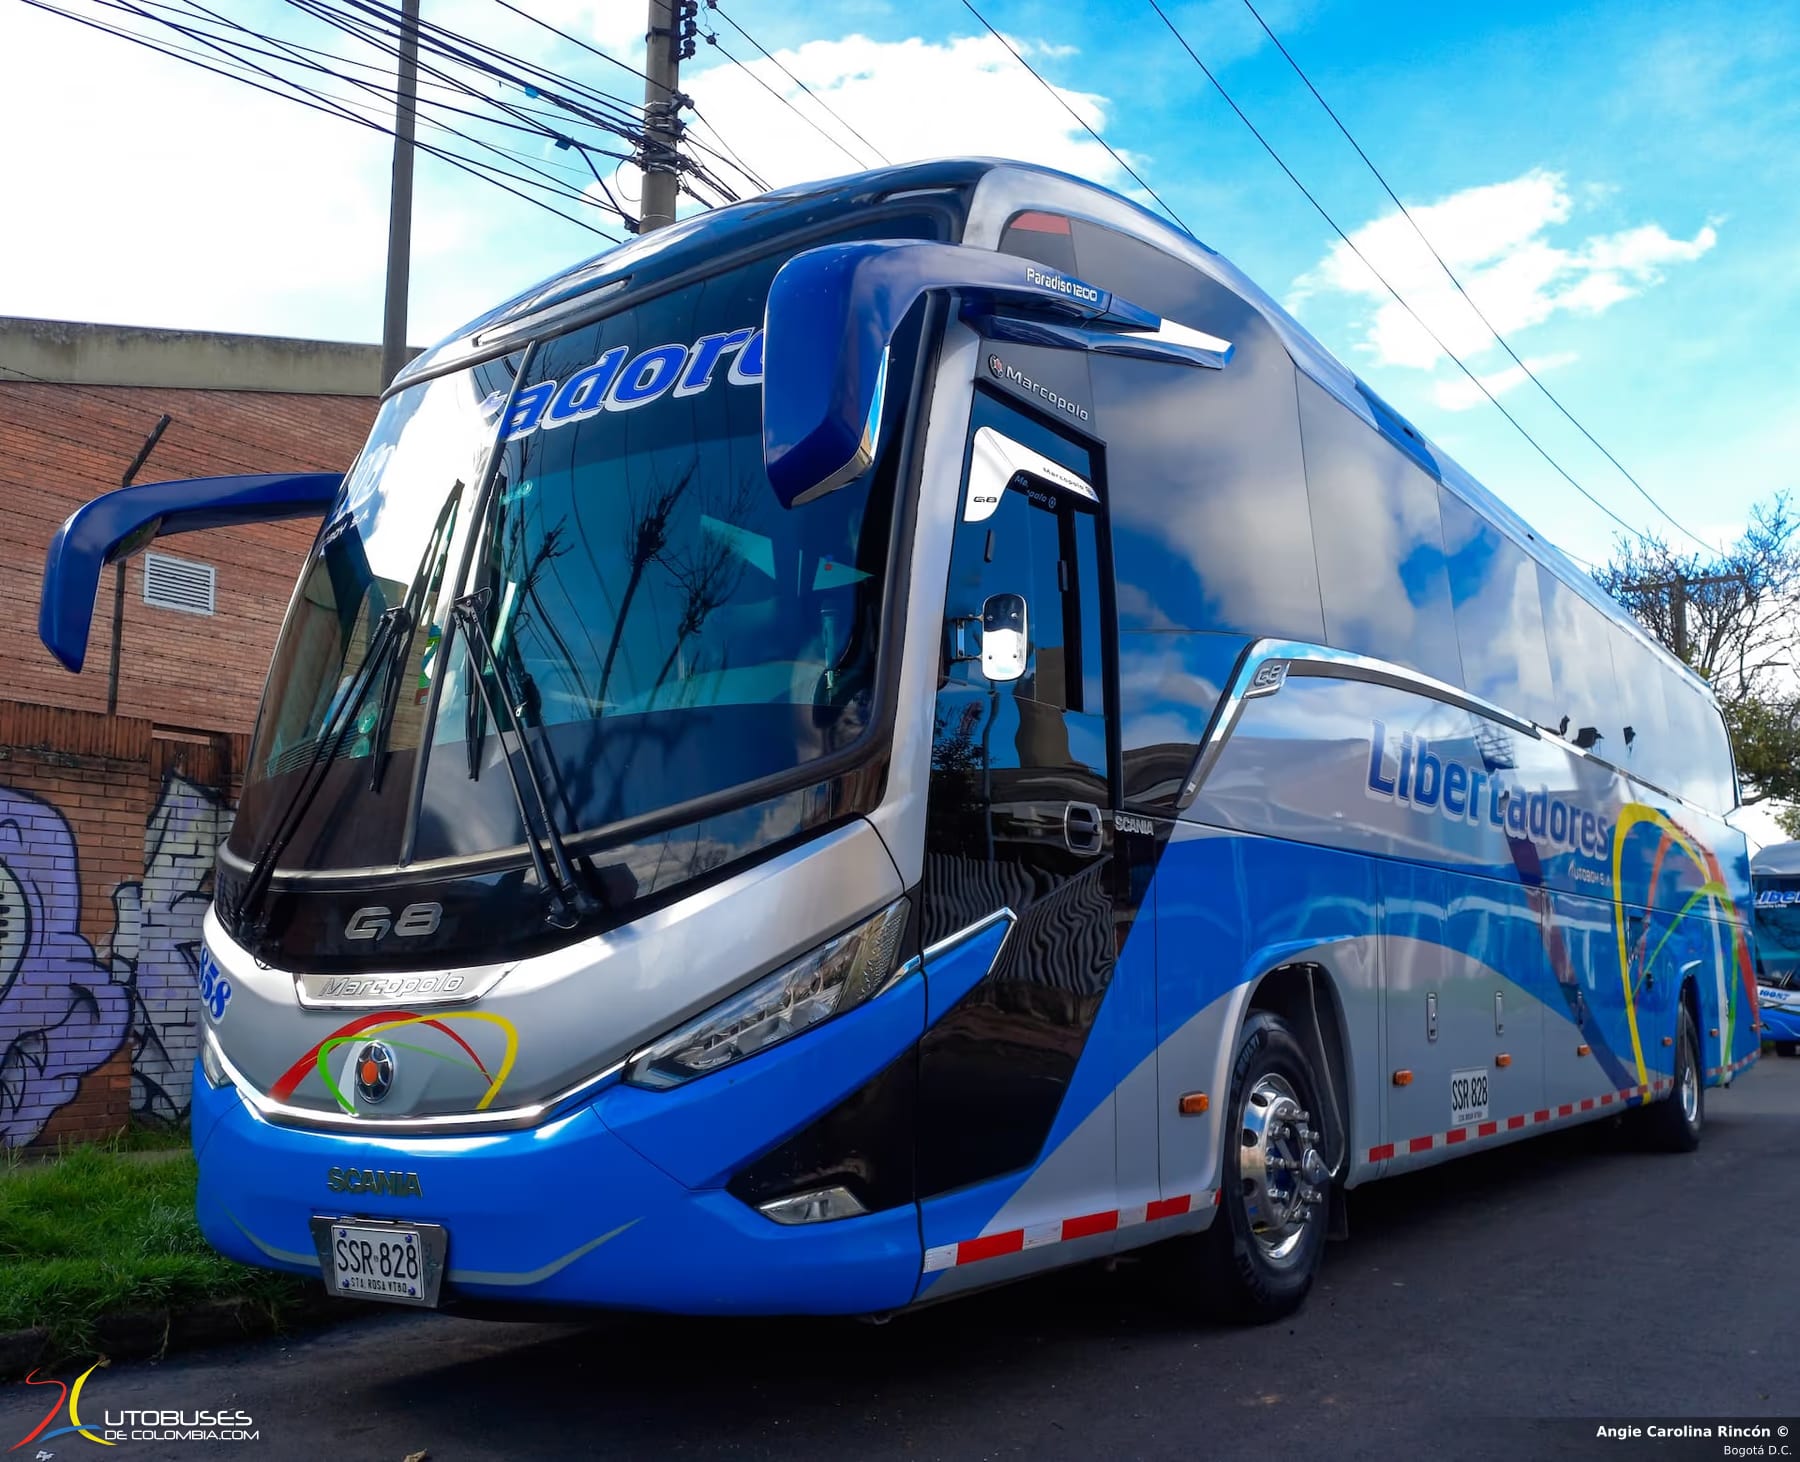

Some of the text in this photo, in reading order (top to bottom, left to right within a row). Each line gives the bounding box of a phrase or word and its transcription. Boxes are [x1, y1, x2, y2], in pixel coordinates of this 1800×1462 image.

[1005, 365, 1089, 422] Marcopolo
[973, 495, 998, 503] G8
[1254, 663, 1282, 687] G8
[1366, 719, 1610, 861] Libertadores
[1114, 815, 1154, 836] SCANIA
[344, 902, 443, 941] G8
[318, 971, 465, 998] Marcopolo
[1452, 1075, 1488, 1111] SSR 828
[327, 1166, 423, 1199] SCANIA
